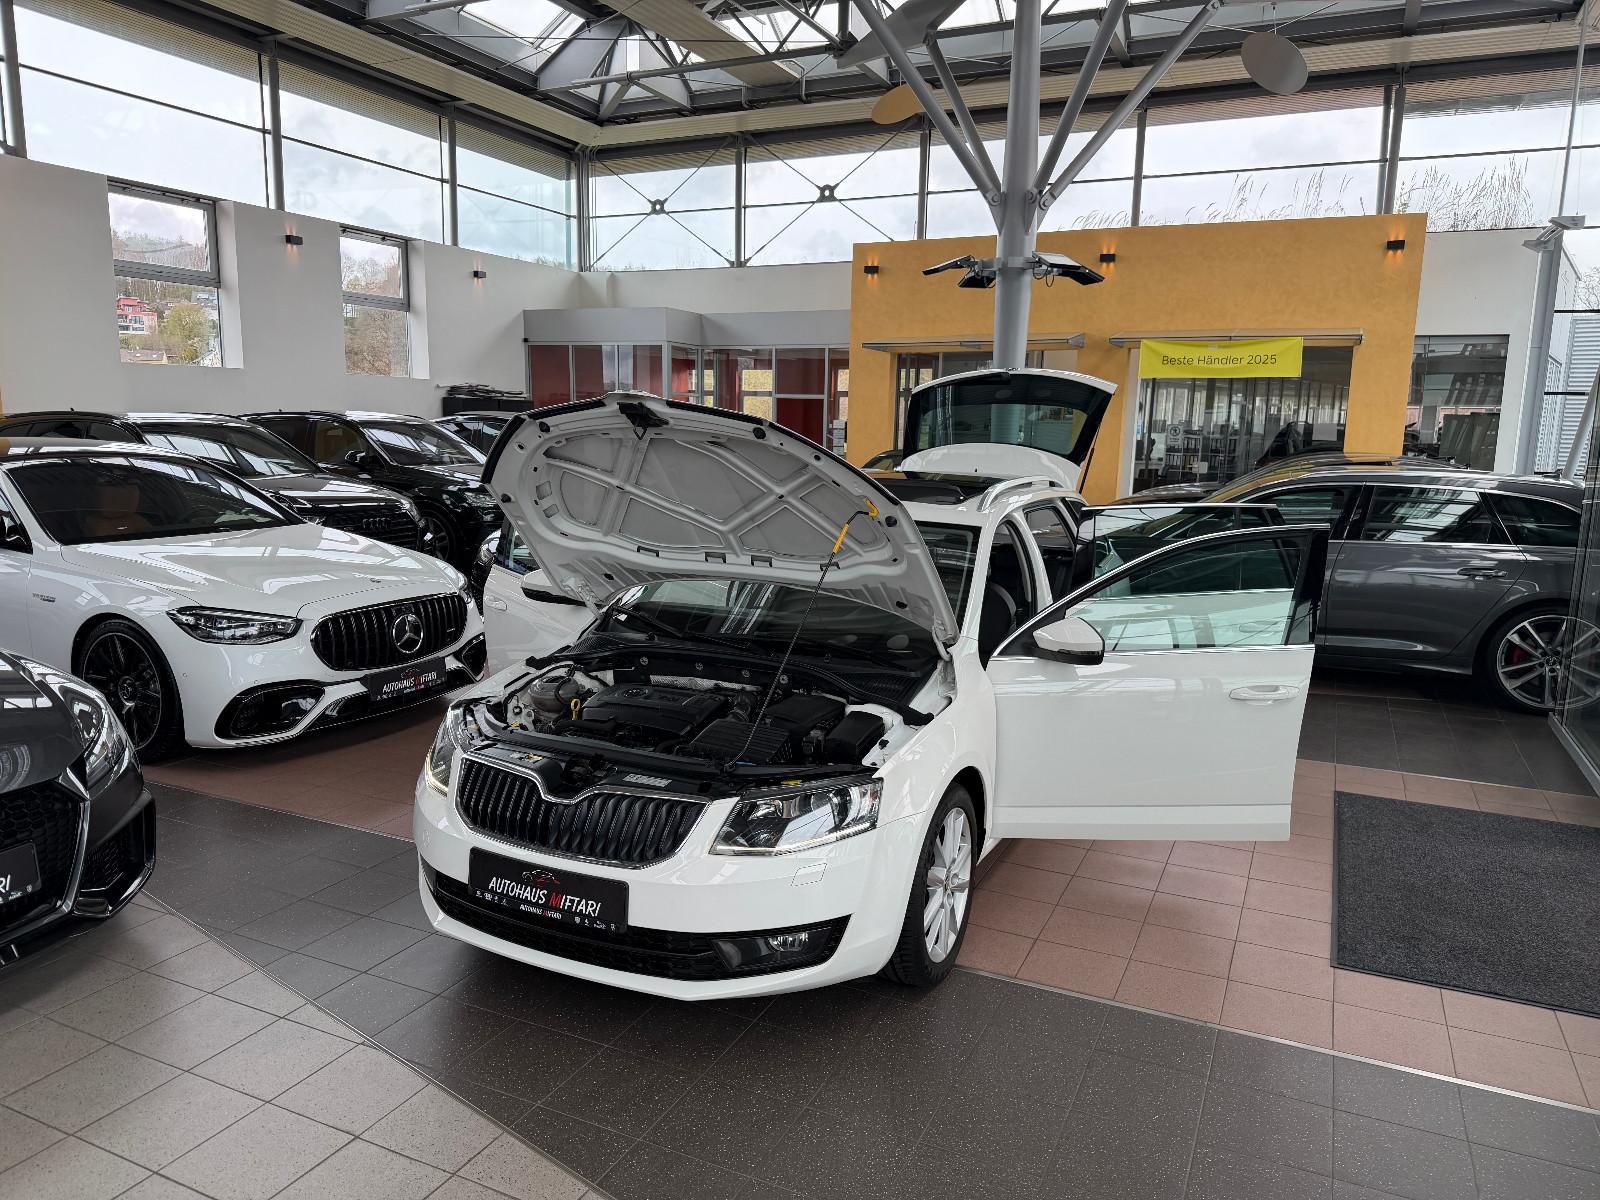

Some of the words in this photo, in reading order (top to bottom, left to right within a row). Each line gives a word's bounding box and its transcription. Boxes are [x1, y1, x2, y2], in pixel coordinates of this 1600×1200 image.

[1162, 355, 1194, 366] Beste
[1198, 355, 1244, 365] Händler
[1247, 354, 1277, 365] 2025
[382, 678, 414, 693] AUTOHAUS
[488, 876, 548, 904] AUTOHAUS
[549, 891, 602, 917] MIFTARI
